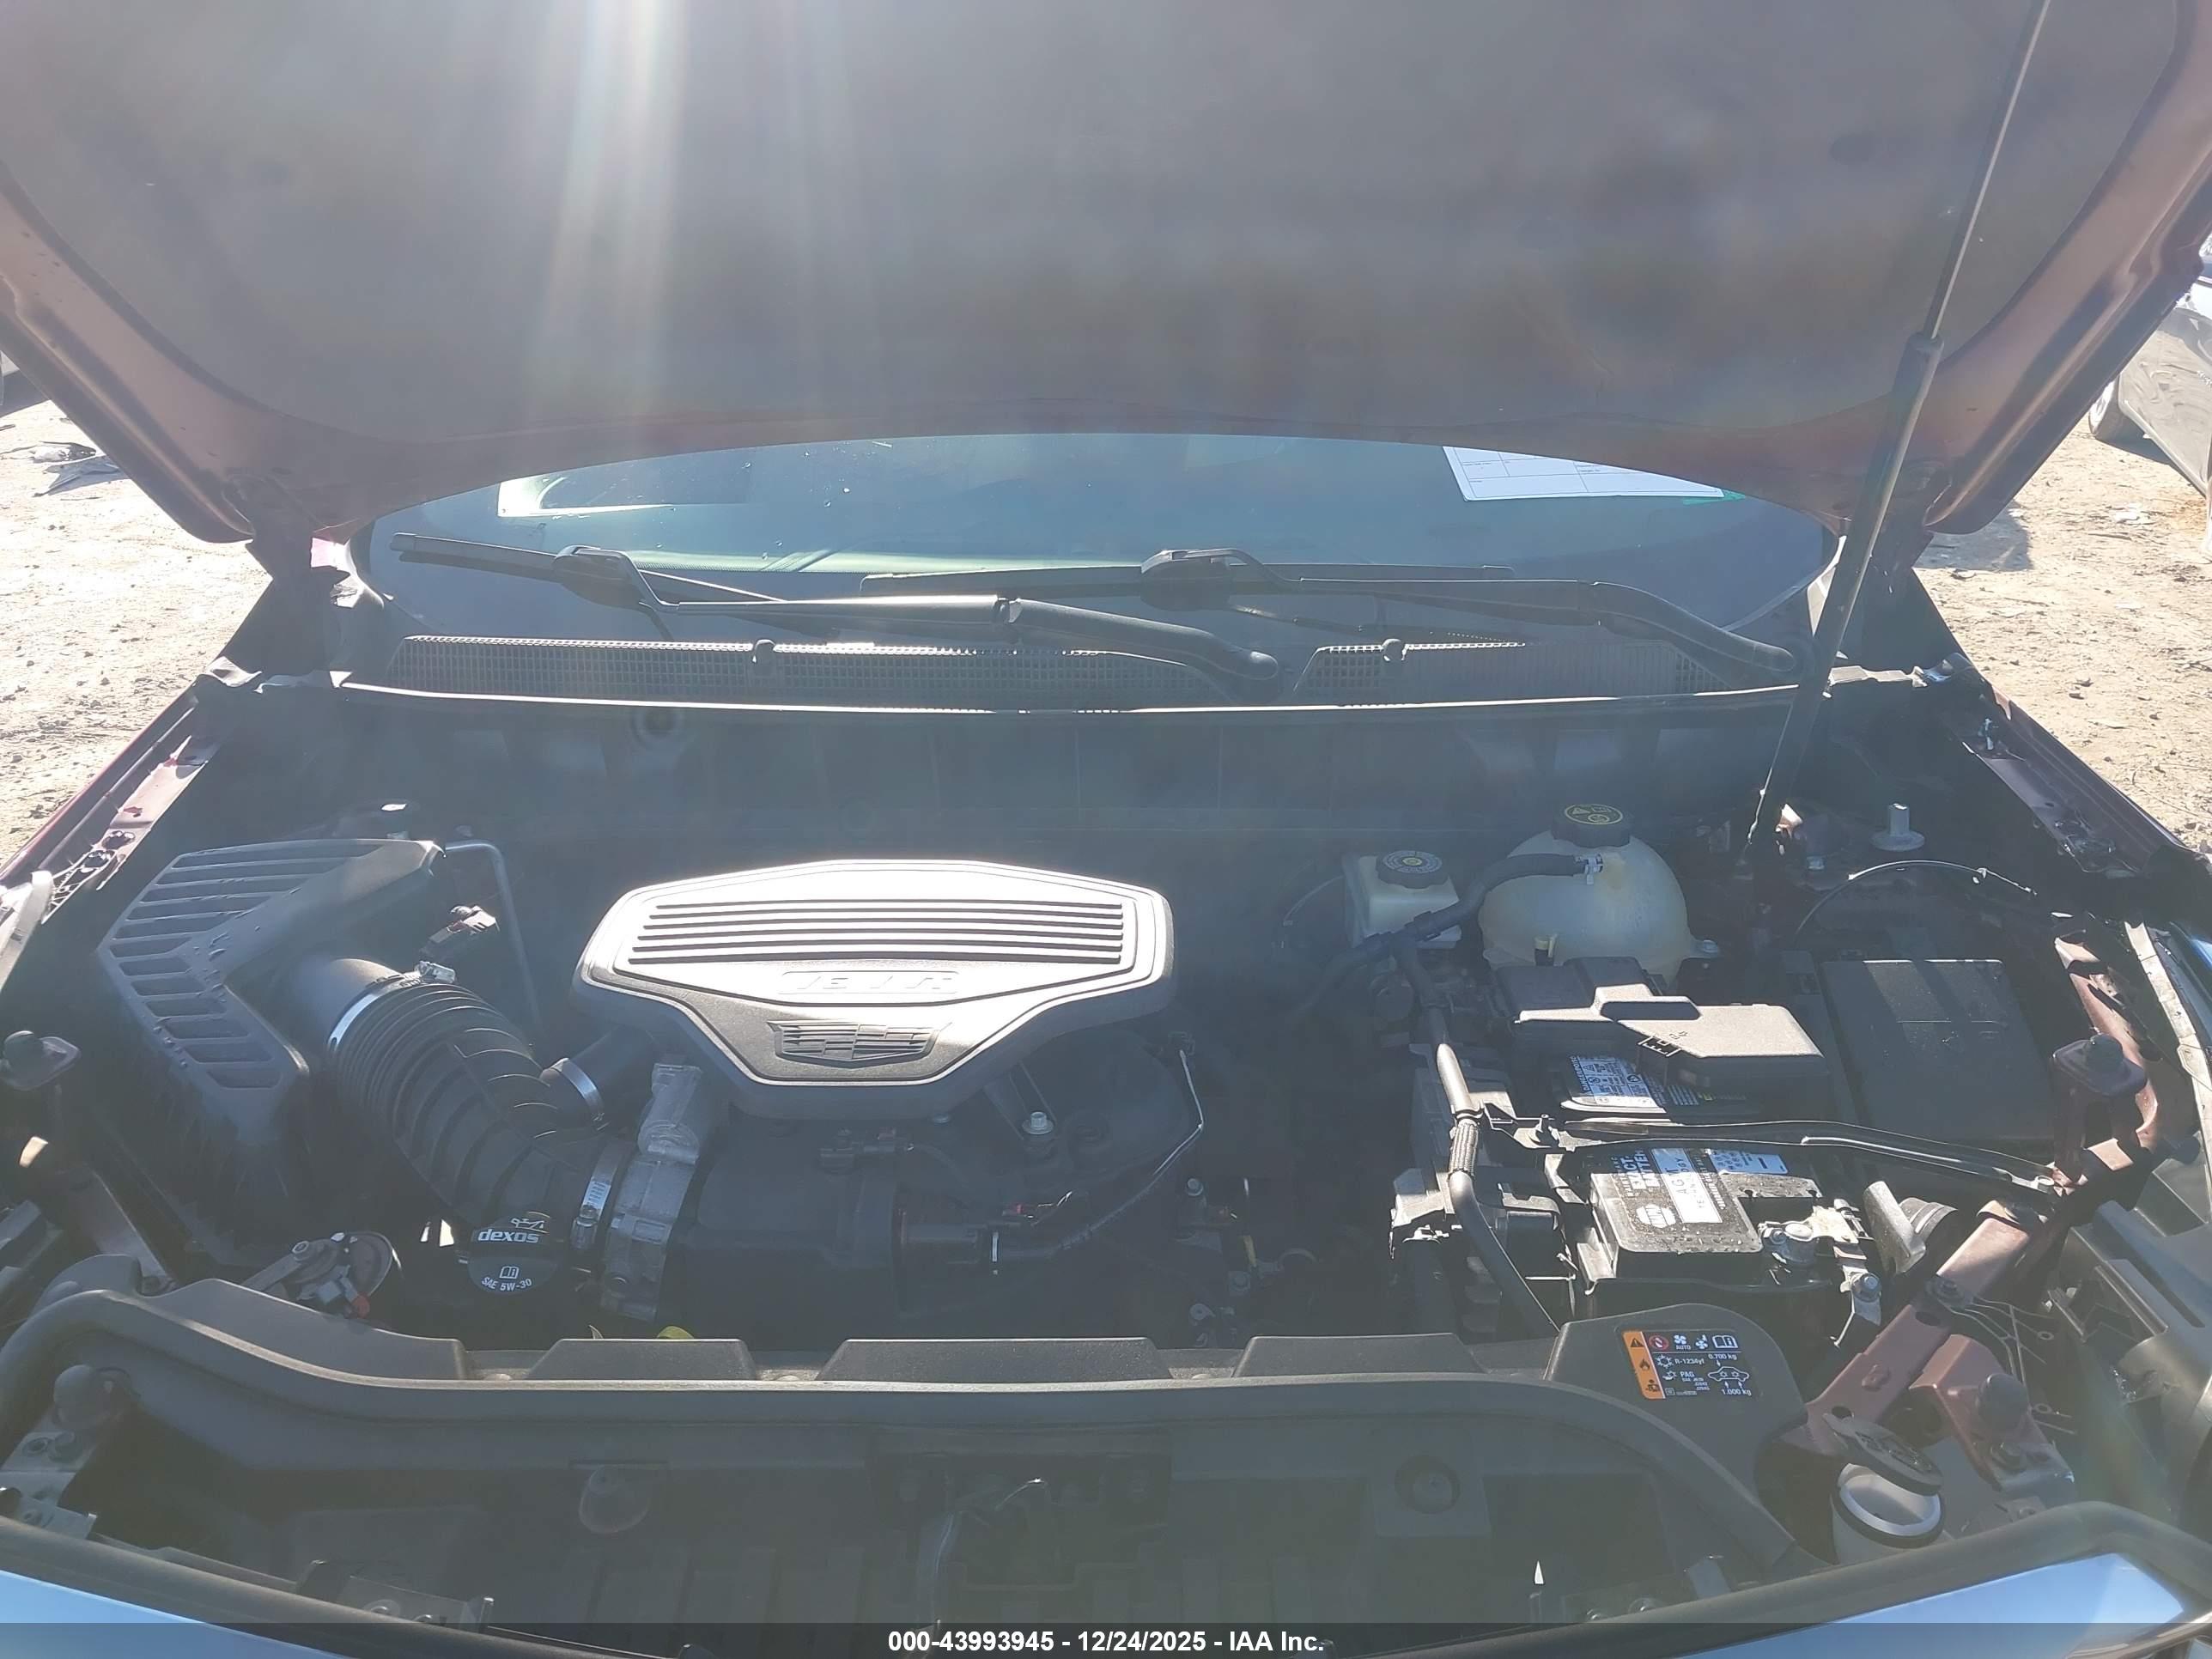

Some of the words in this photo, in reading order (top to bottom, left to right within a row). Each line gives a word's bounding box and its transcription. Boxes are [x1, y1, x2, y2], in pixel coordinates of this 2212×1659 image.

[477, 1228, 539, 1244] dexos
[482, 1276, 498, 1291] SAE
[500, 1278, 532, 1292] 5W-30
